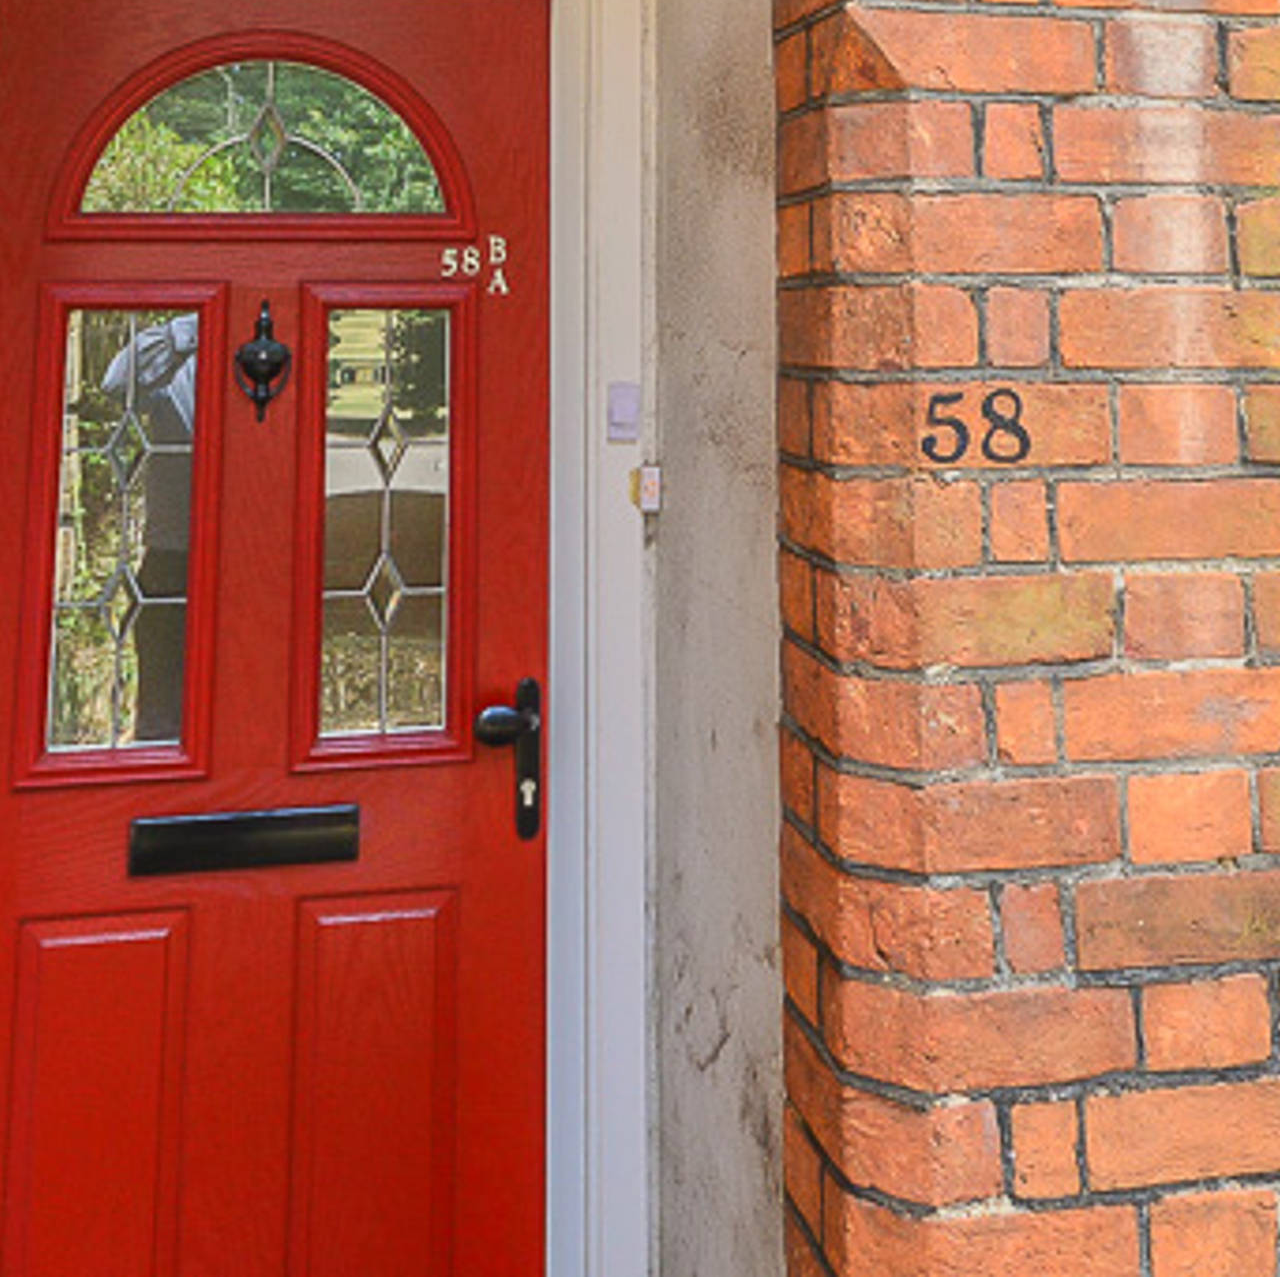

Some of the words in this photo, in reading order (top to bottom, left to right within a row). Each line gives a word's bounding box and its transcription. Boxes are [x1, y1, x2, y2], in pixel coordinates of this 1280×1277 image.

[441, 246, 480, 277] 58
[488, 234, 507, 264] B
[487, 268, 509, 294] A
[921, 388, 1031, 463] 58
